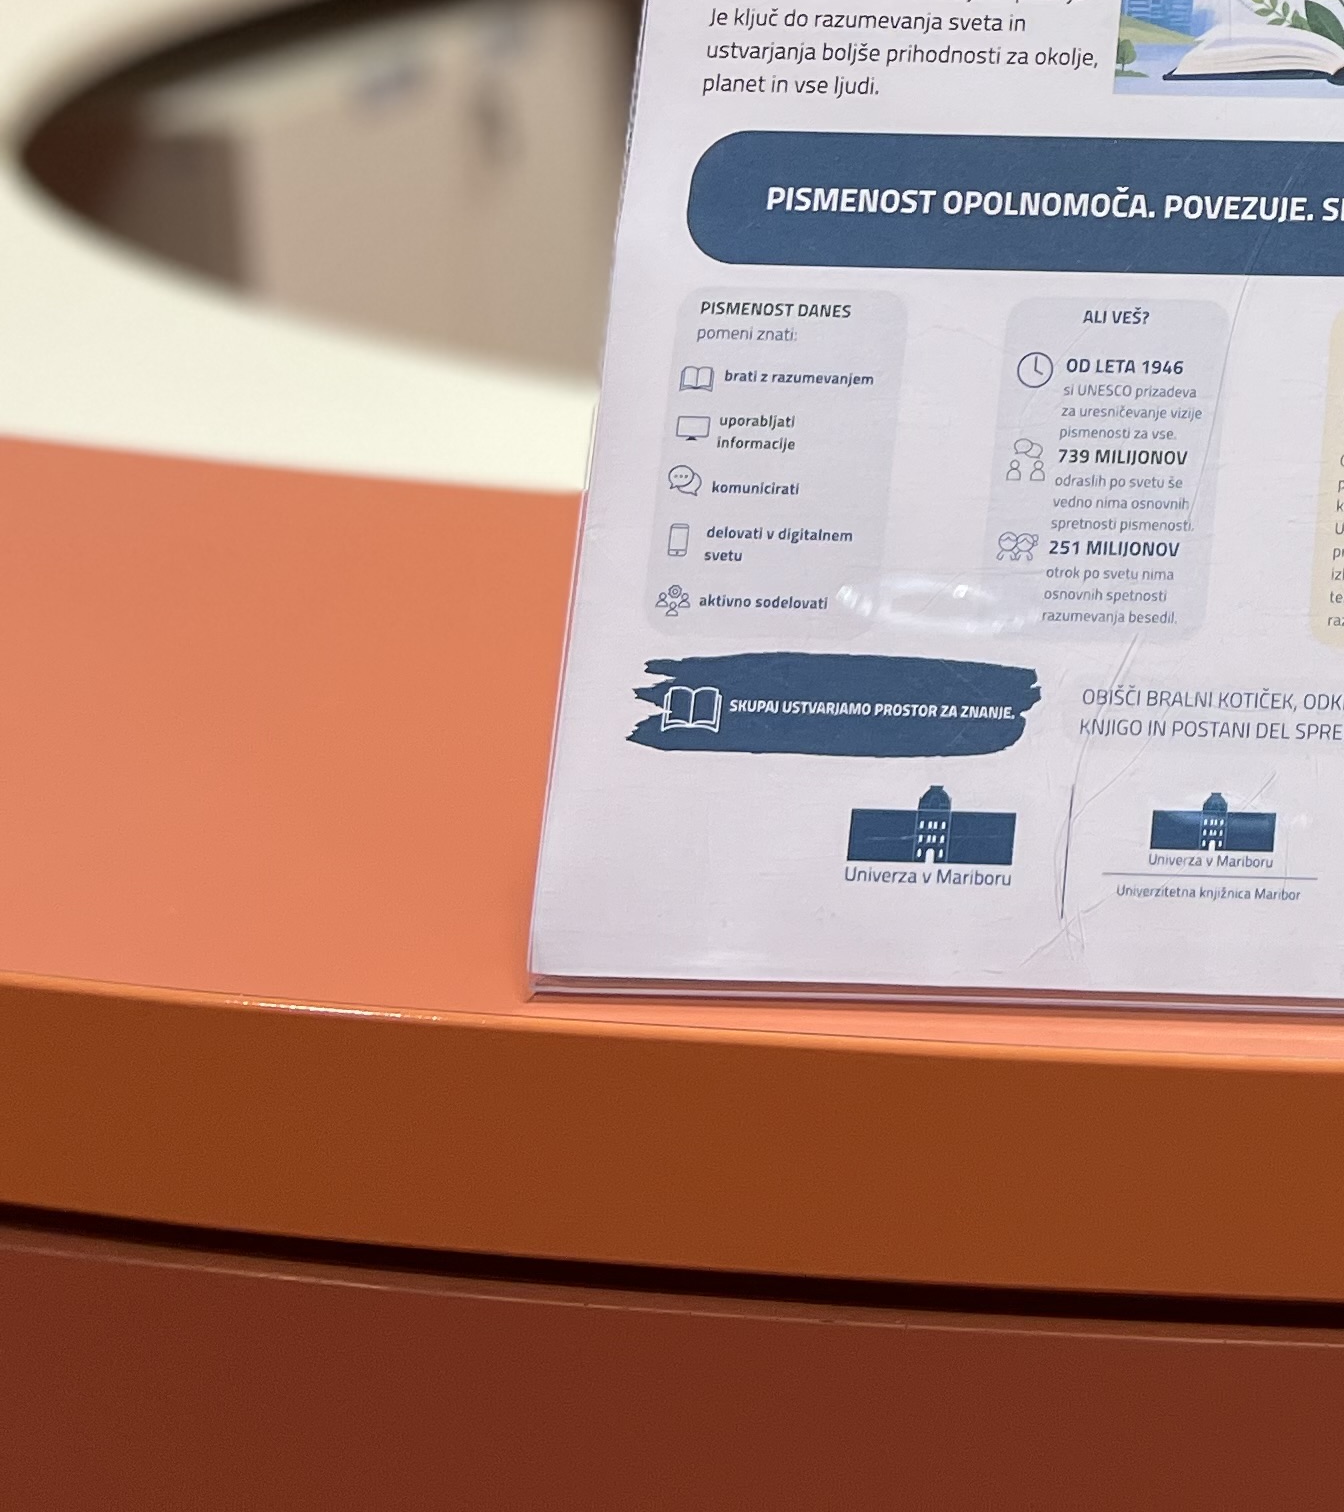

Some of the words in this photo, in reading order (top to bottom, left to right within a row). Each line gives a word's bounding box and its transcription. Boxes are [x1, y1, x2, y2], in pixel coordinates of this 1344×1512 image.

[708, 8, 728, 27] Je
[733, 7, 778, 31] ključ
[783, 8, 808, 27] do
[814, 12, 942, 34] razumevanja
[948, 14, 1003, 32] sveta
[1008, 14, 1026, 31] in
[706, 41, 816, 65] ustvarjanja
[822, 42, 880, 66] boljše
[885, 44, 1001, 67] prihodnosti
[1006, 51, 1029, 65] za
[1034, 46, 1098, 70] okolje,
[702, 73, 766, 96] planet
[771, 75, 788, 93] in
[794, 79, 828, 94] vse
[833, 75, 879, 99] ljudi.
[766, 186, 937, 214] PISMENOST
[942, 186, 1155, 218] OPOLNOMOČA.
[1164, 194, 1313, 223] POVEZUJE.
[700, 300, 794, 317] PISMENOST
[797, 303, 851, 318] DANES
[1082, 310, 1107, 324] ALI
[1111, 306, 1150, 325] VEŠ?
[1066, 358, 1090, 373] OD
[1095, 359, 1135, 373] LETA
[1142, 360, 1184, 375] 1946
[724, 369, 757, 382] brati
[760, 373, 768, 382] z
[771, 373, 874, 388] razumevanjem
[1058, 448, 1089, 463] 739
[1094, 449, 1188, 466] MILIJONOV
[711, 480, 799, 495] komunicirati
[1048, 540, 1079, 555] 251
[1086, 540, 1180, 557] MILIJONOV
[698, 593, 751, 608] aktivno
[755, 595, 828, 610] sodelovati
[729, 699, 779, 714] SKUPAJ
[782, 700, 871, 715] USTVARJAMO
[874, 703, 938, 717] PROSTOR
[939, 704, 957, 717] ZA
[960, 705, 1015, 720] ZNANJE.
[844, 866, 917, 884] Univerza
[922, 872, 932, 884] v
[936, 868, 1011, 886] Mariboru
[1116, 884, 1196, 898] Univerzitetna
[1199, 886, 1251, 901] knjižnica
[1254, 887, 1301, 901] Maribor
